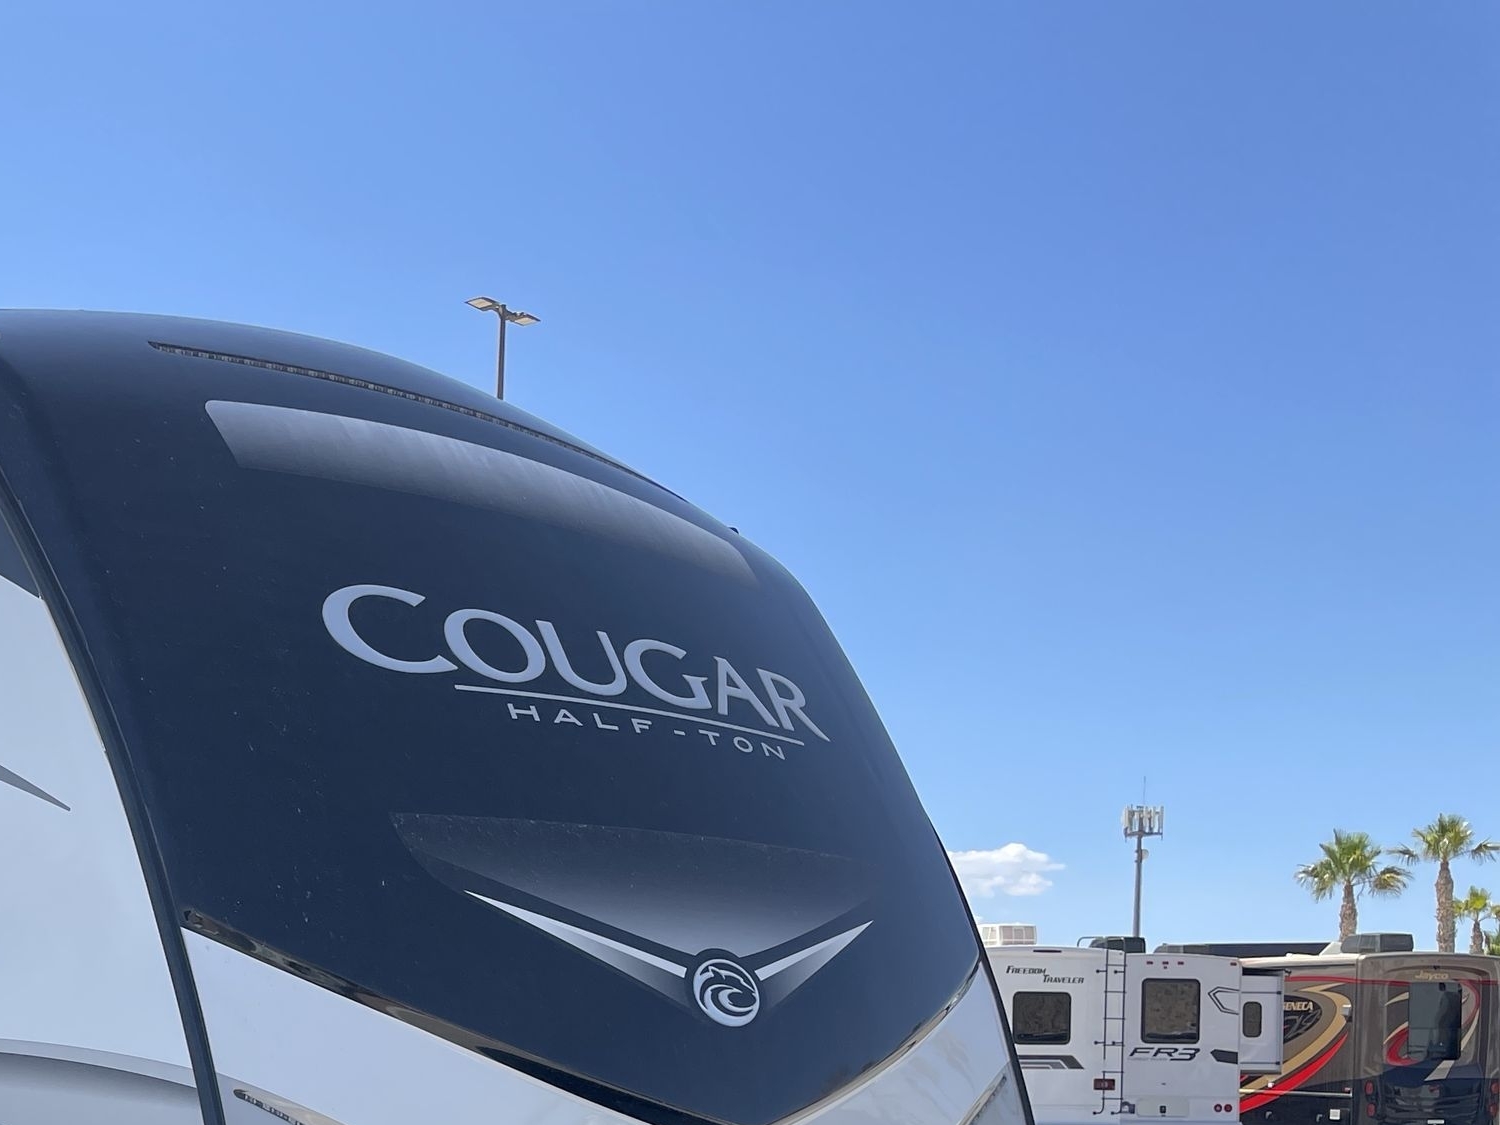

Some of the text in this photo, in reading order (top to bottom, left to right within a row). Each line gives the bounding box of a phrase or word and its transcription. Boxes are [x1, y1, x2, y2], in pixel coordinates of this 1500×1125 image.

[322, 584, 831, 742] COUGAR
[506, 703, 786, 760] HALF-TON
[1006, 965, 1047, 975] FREEDOM
[1414, 969, 1449, 981] Jayco
[1043, 974, 1085, 985] TRAVELER
[1129, 1047, 1201, 1061] FR3
